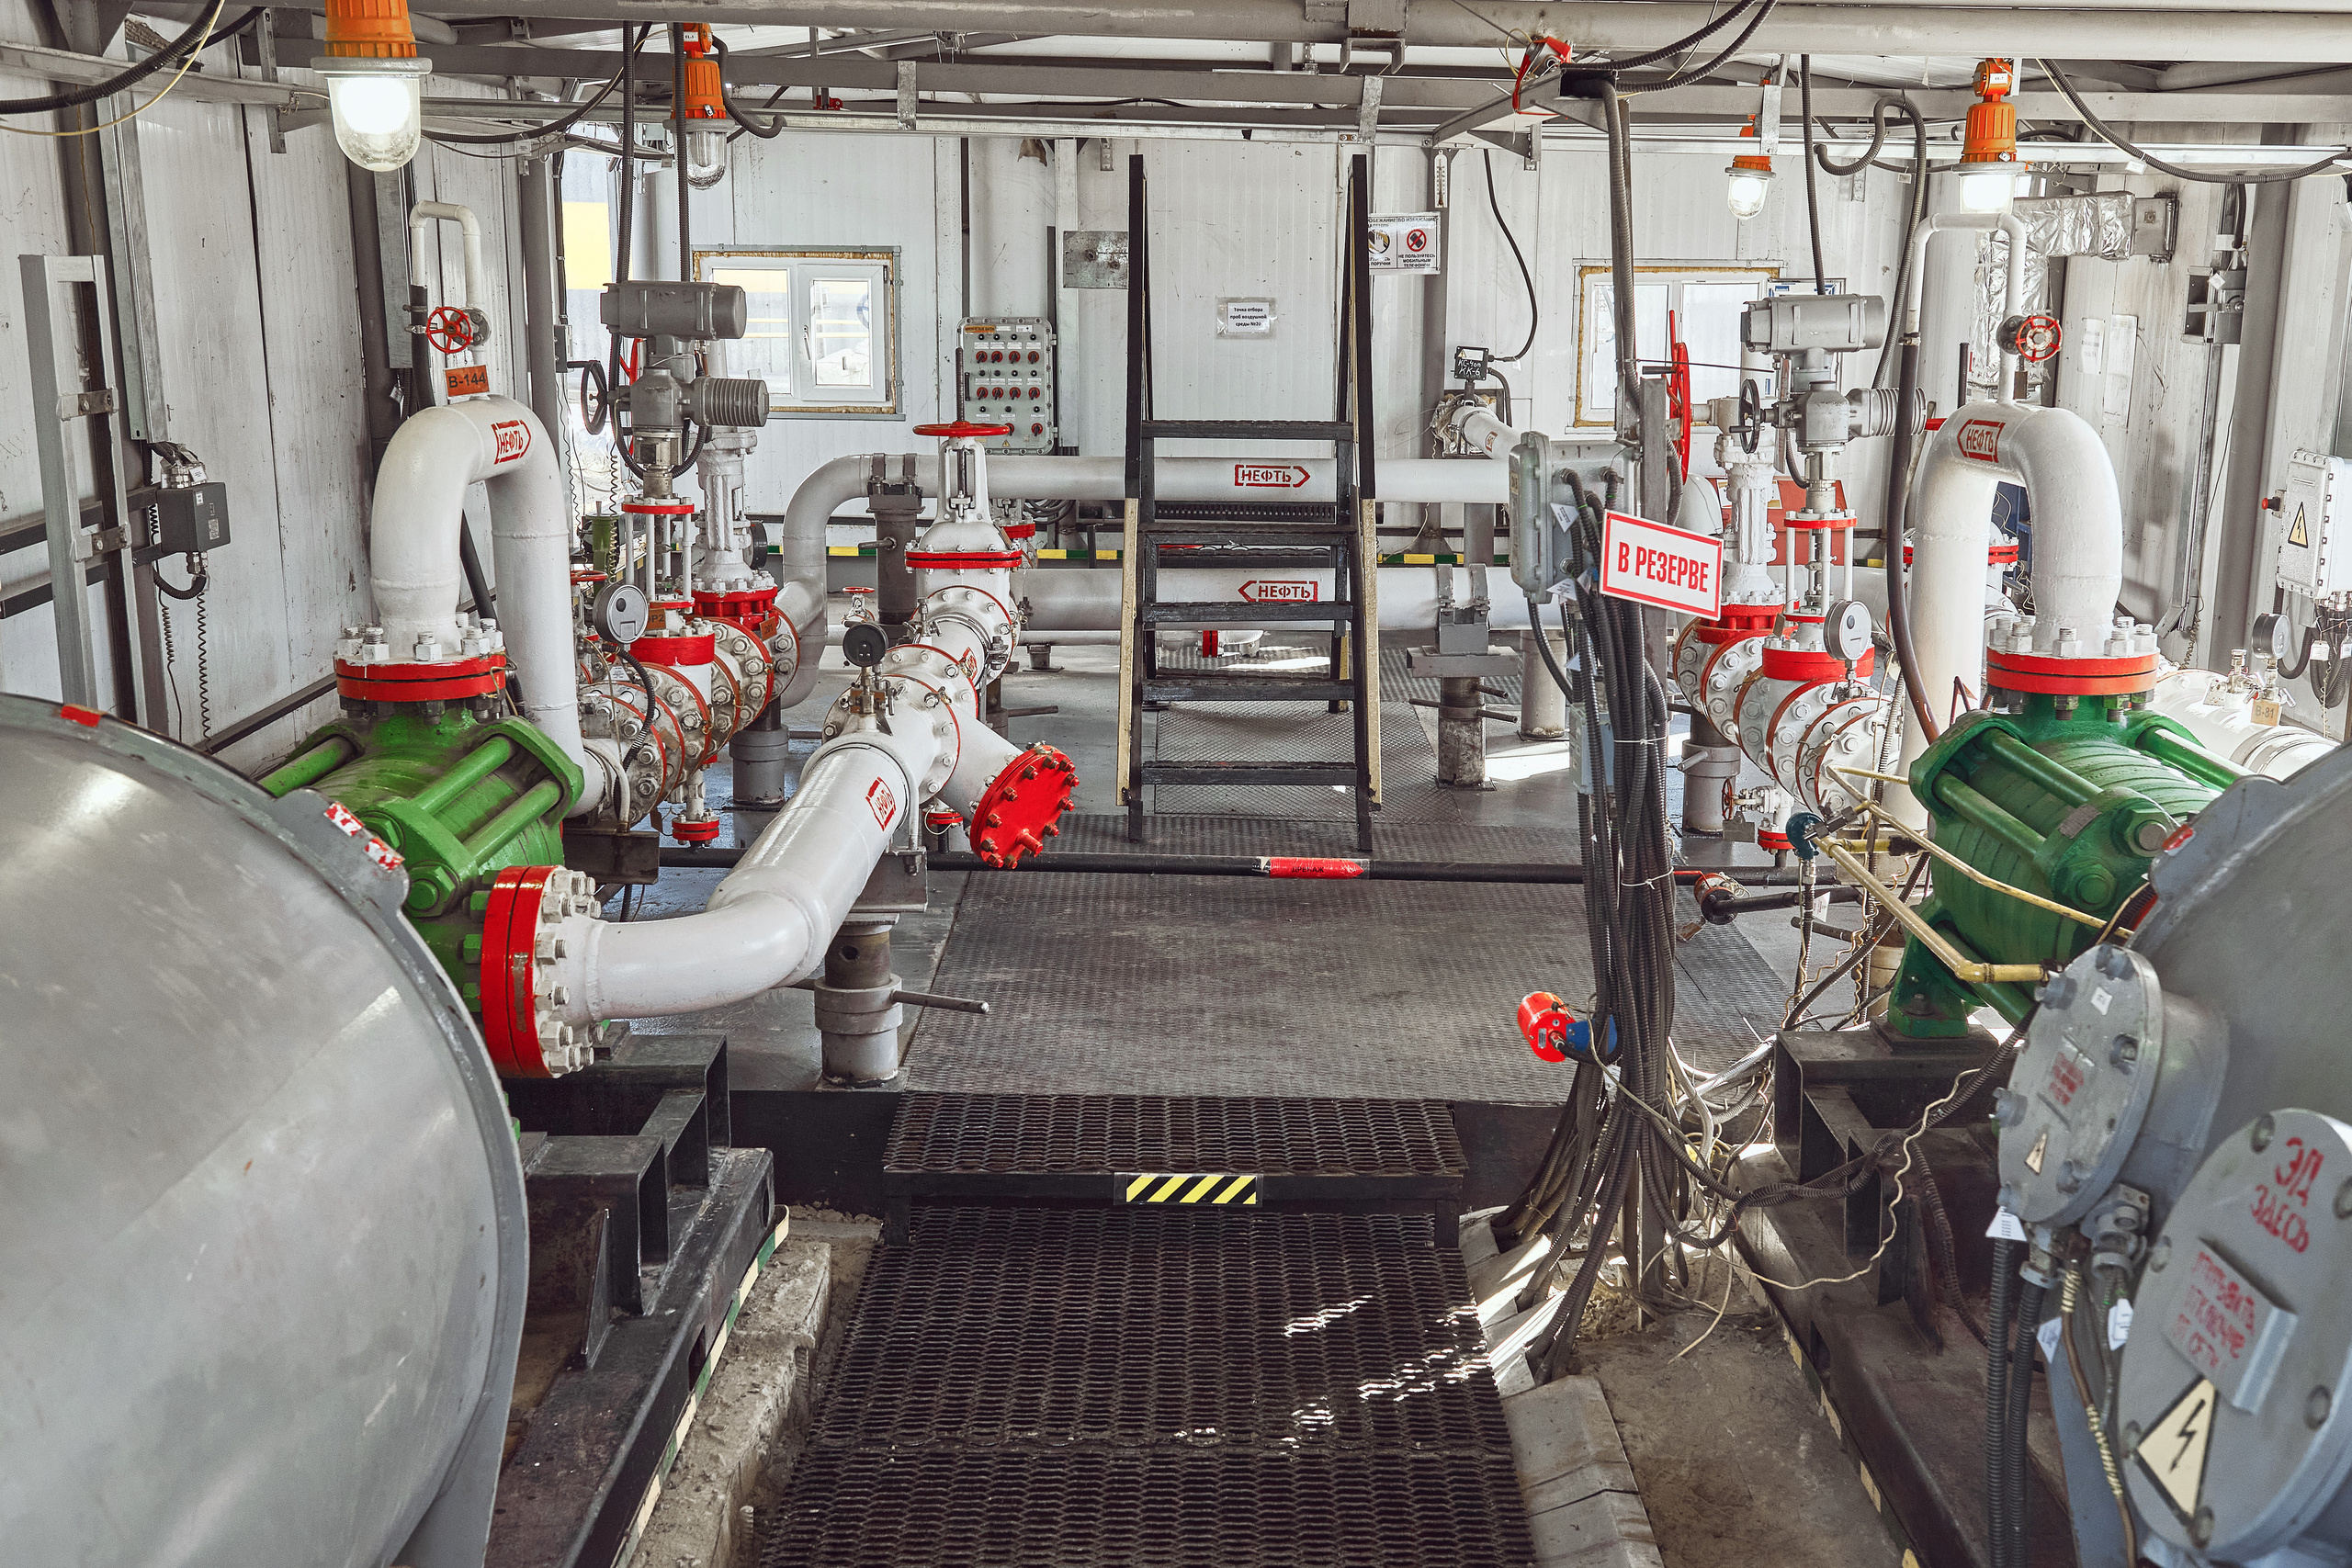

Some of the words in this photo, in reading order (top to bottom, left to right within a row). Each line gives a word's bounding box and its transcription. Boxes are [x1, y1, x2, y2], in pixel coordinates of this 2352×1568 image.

[448, 372, 487, 389] В-144
[499, 430, 524, 455] НЕФТЬ
[1966, 428, 1994, 453] НЕФТЬ
[1241, 469, 1292, 483] НЕФТЬ
[1617, 541, 1630, 573] В
[1635, 546, 1709, 592] РЕЗЕРВЕ
[1258, 585, 1311, 598] НЕФТЬ
[1291, 865, 1325, 874] ДРЕНАЖ
